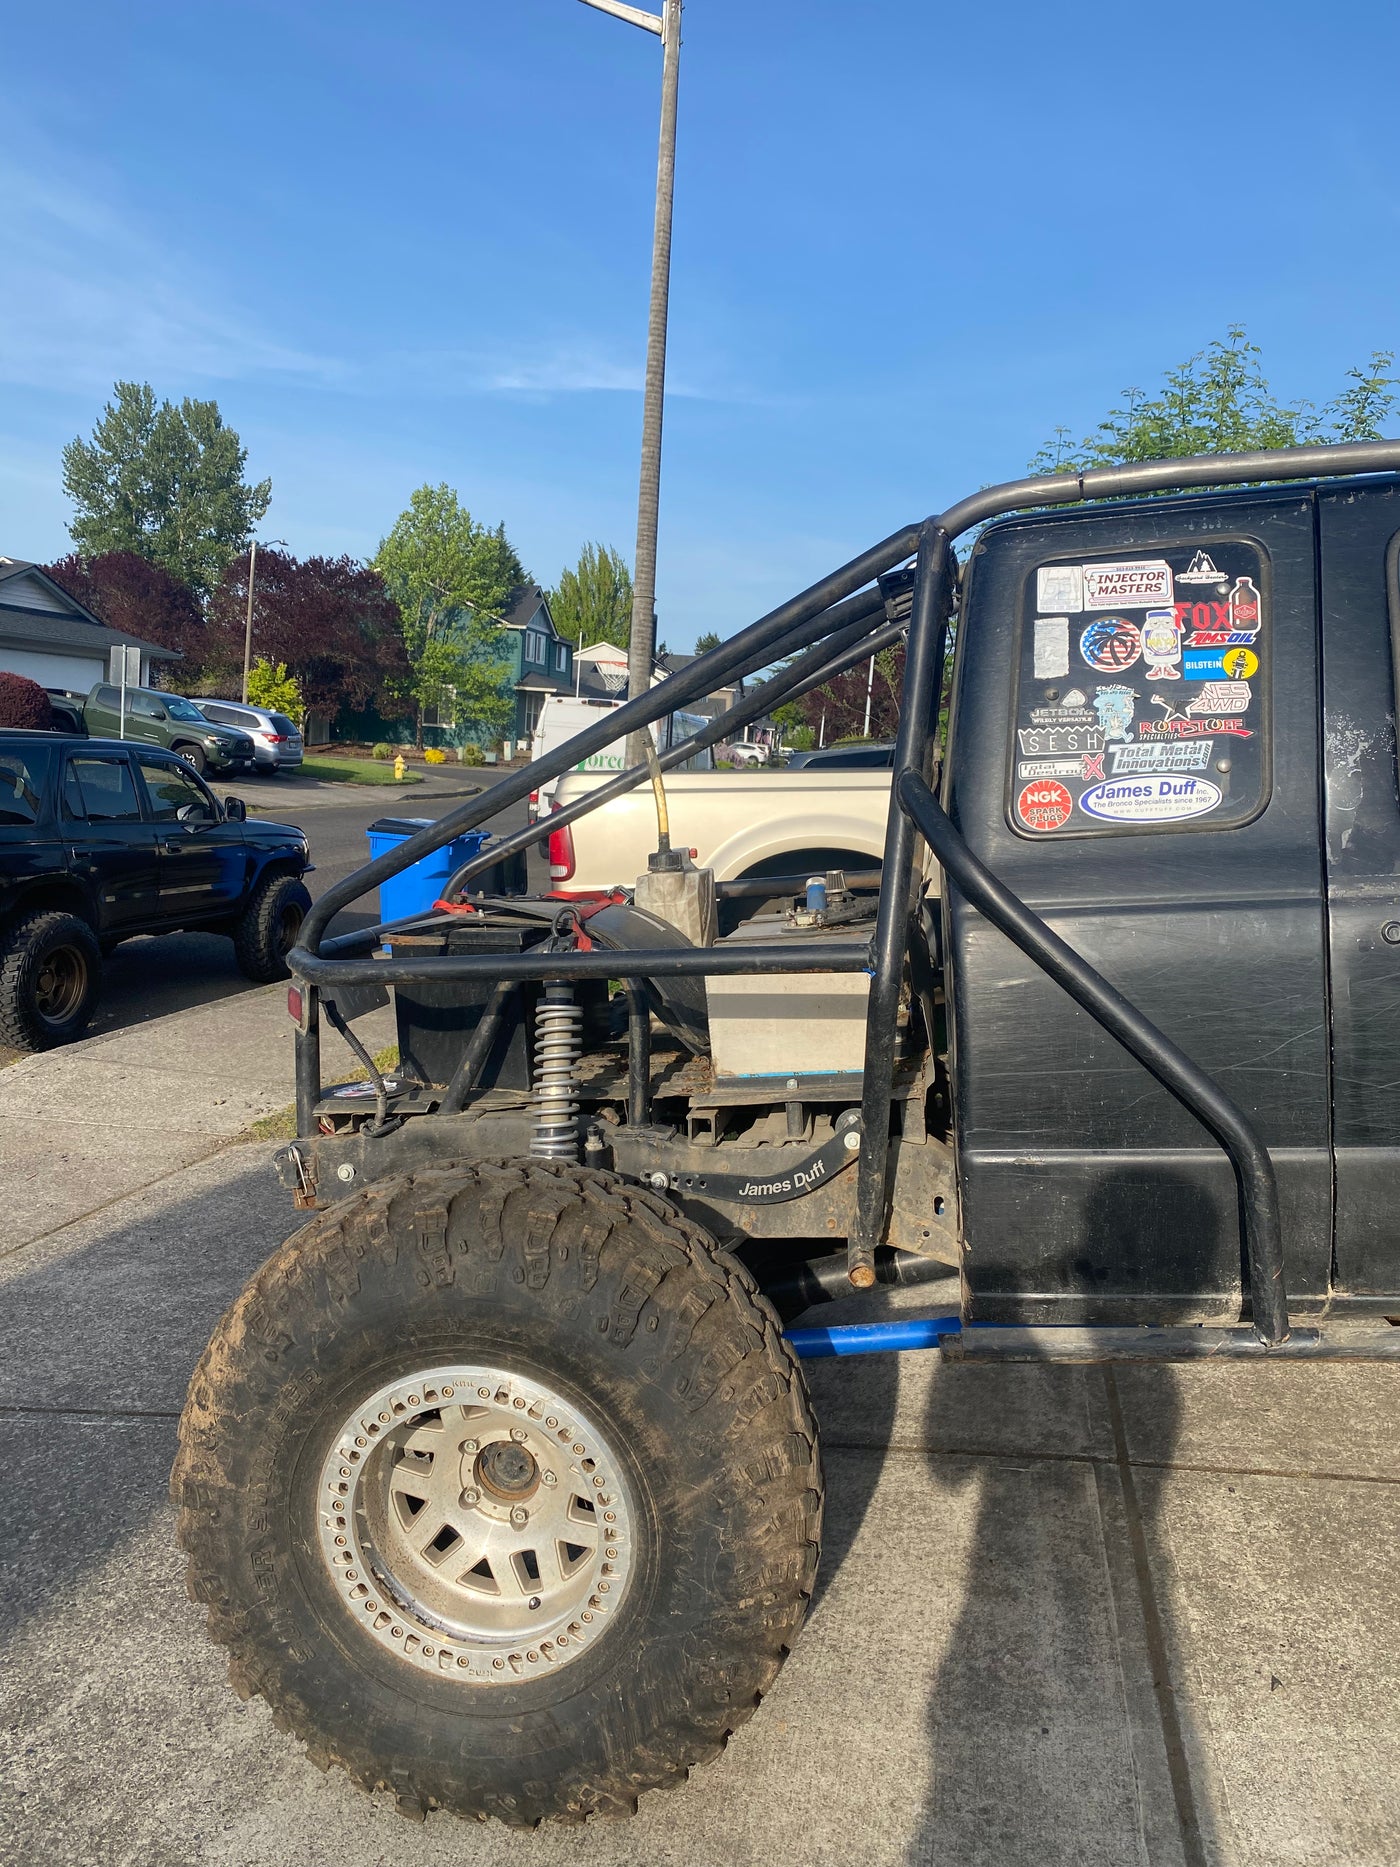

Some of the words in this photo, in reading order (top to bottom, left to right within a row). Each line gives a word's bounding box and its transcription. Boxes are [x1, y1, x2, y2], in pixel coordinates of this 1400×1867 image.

[1097, 572, 1165, 584] INJECTOR
[1098, 583, 1162, 595] MASTERS
[1174, 602, 1233, 631] FOX
[1189, 632, 1254, 645] AMSOIL
[1185, 660, 1222, 669] BILSTEIN
[1191, 699, 1246, 711] 4WD
[1029, 733, 1097, 751] SESH
[1139, 732, 1178, 740] SPECIALTIES
[1119, 746, 1154, 757] Total
[1160, 744, 1203, 756] Metal
[1117, 757, 1200, 769] Innovations
[1096, 785, 1152, 799] James
[1159, 781, 1197, 795] Duff
[1027, 790, 1062, 804] NGK
[1134, 798, 1172, 806] Specialists
[1029, 807, 1061, 815] SPARK
[1029, 814, 1062, 822] PLUGS
[739, 1180, 791, 1196] James
[793, 1160, 825, 1188] Duff
